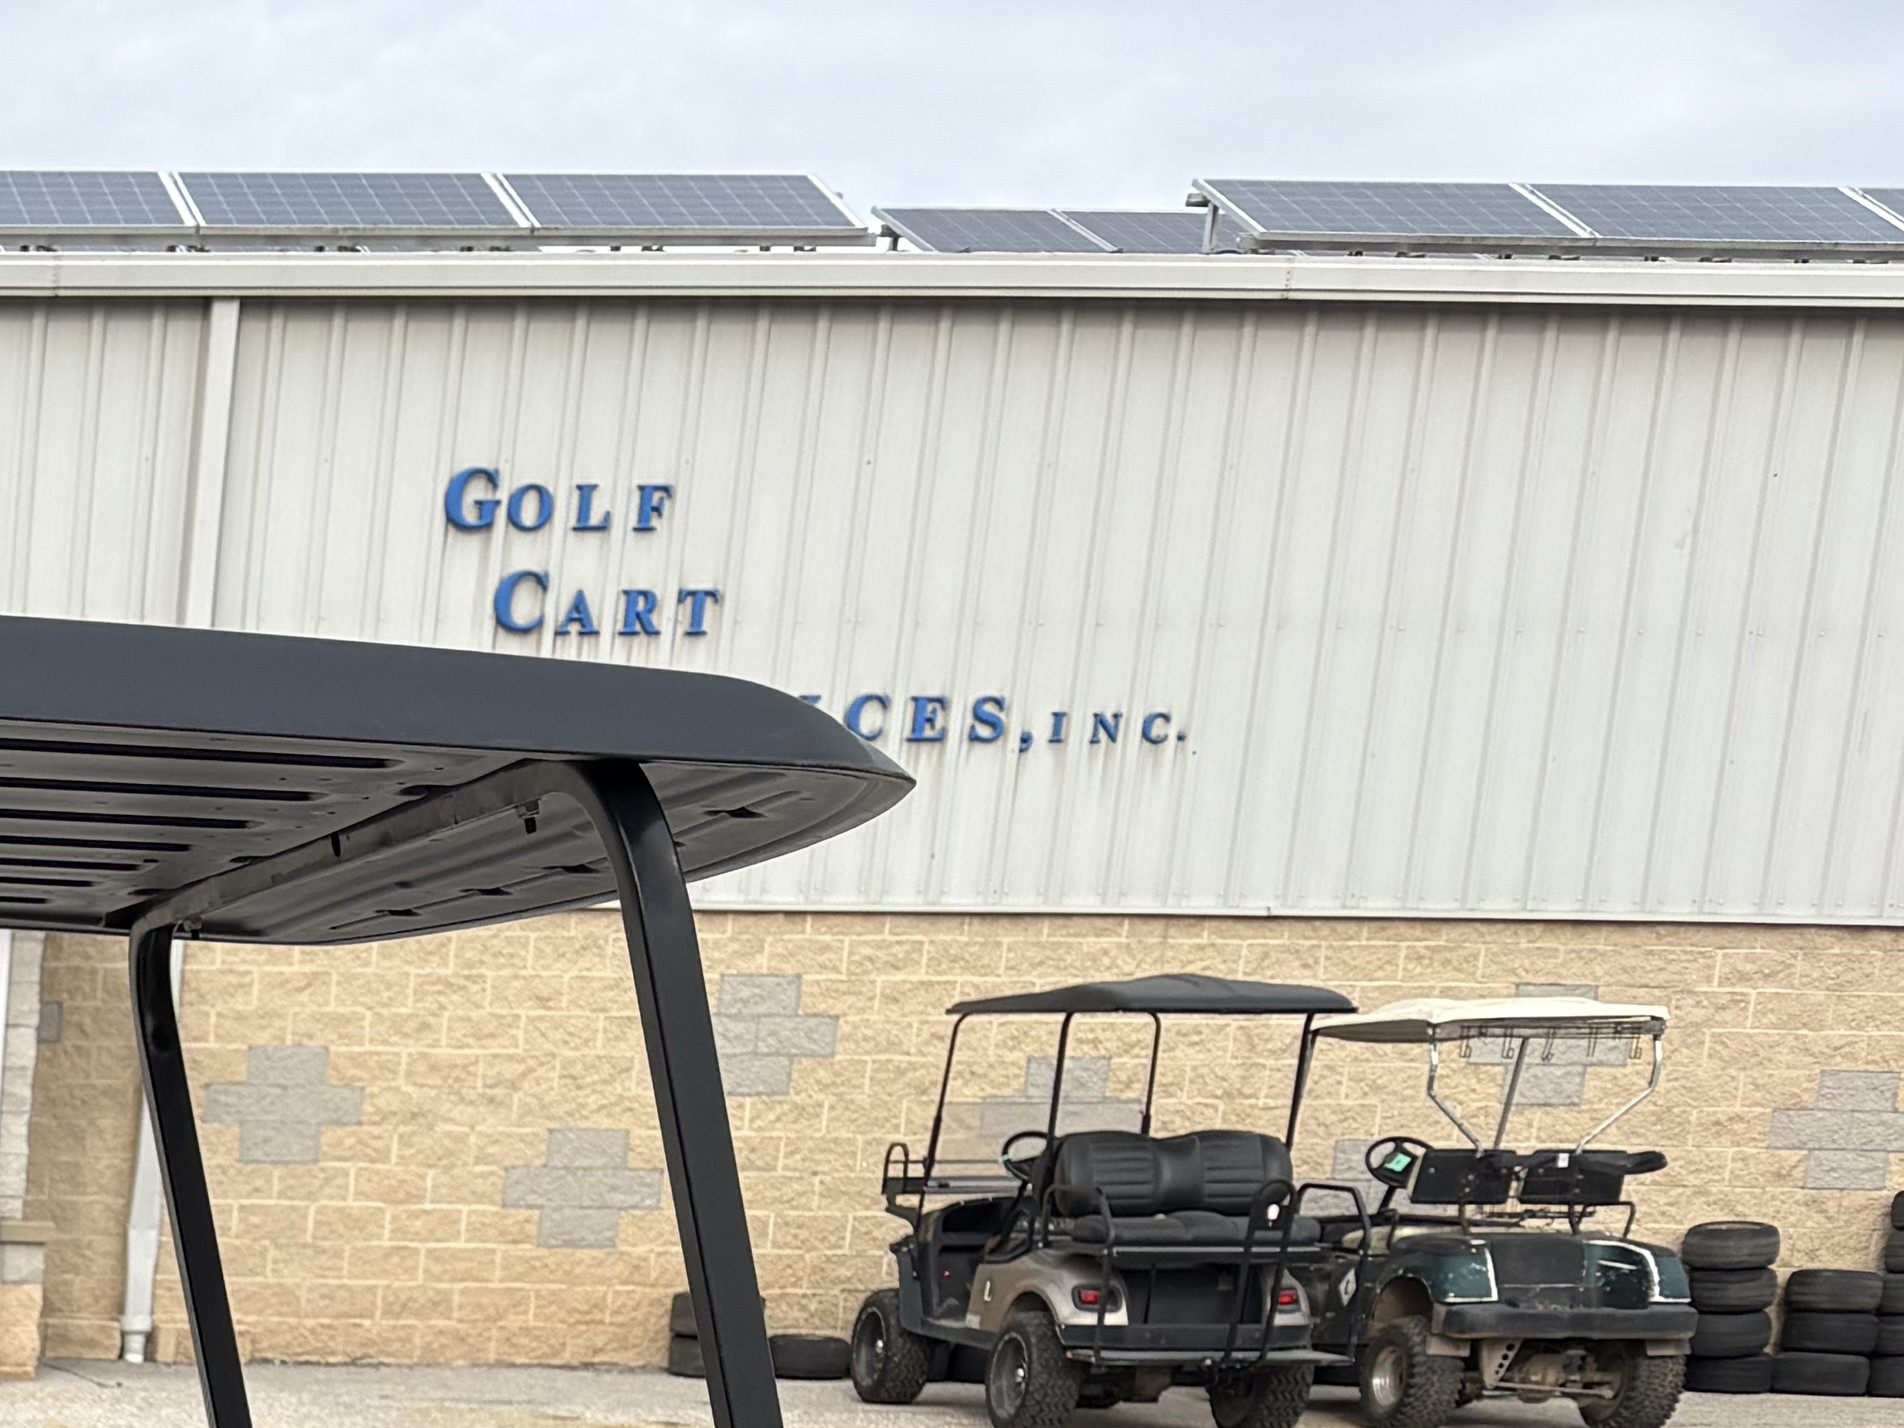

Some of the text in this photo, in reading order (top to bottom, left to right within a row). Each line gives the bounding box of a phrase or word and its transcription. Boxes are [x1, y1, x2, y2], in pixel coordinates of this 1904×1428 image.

[443, 466, 675, 533] GOLF
[494, 570, 721, 637] CART
[794, 693, 1034, 753] CES,
